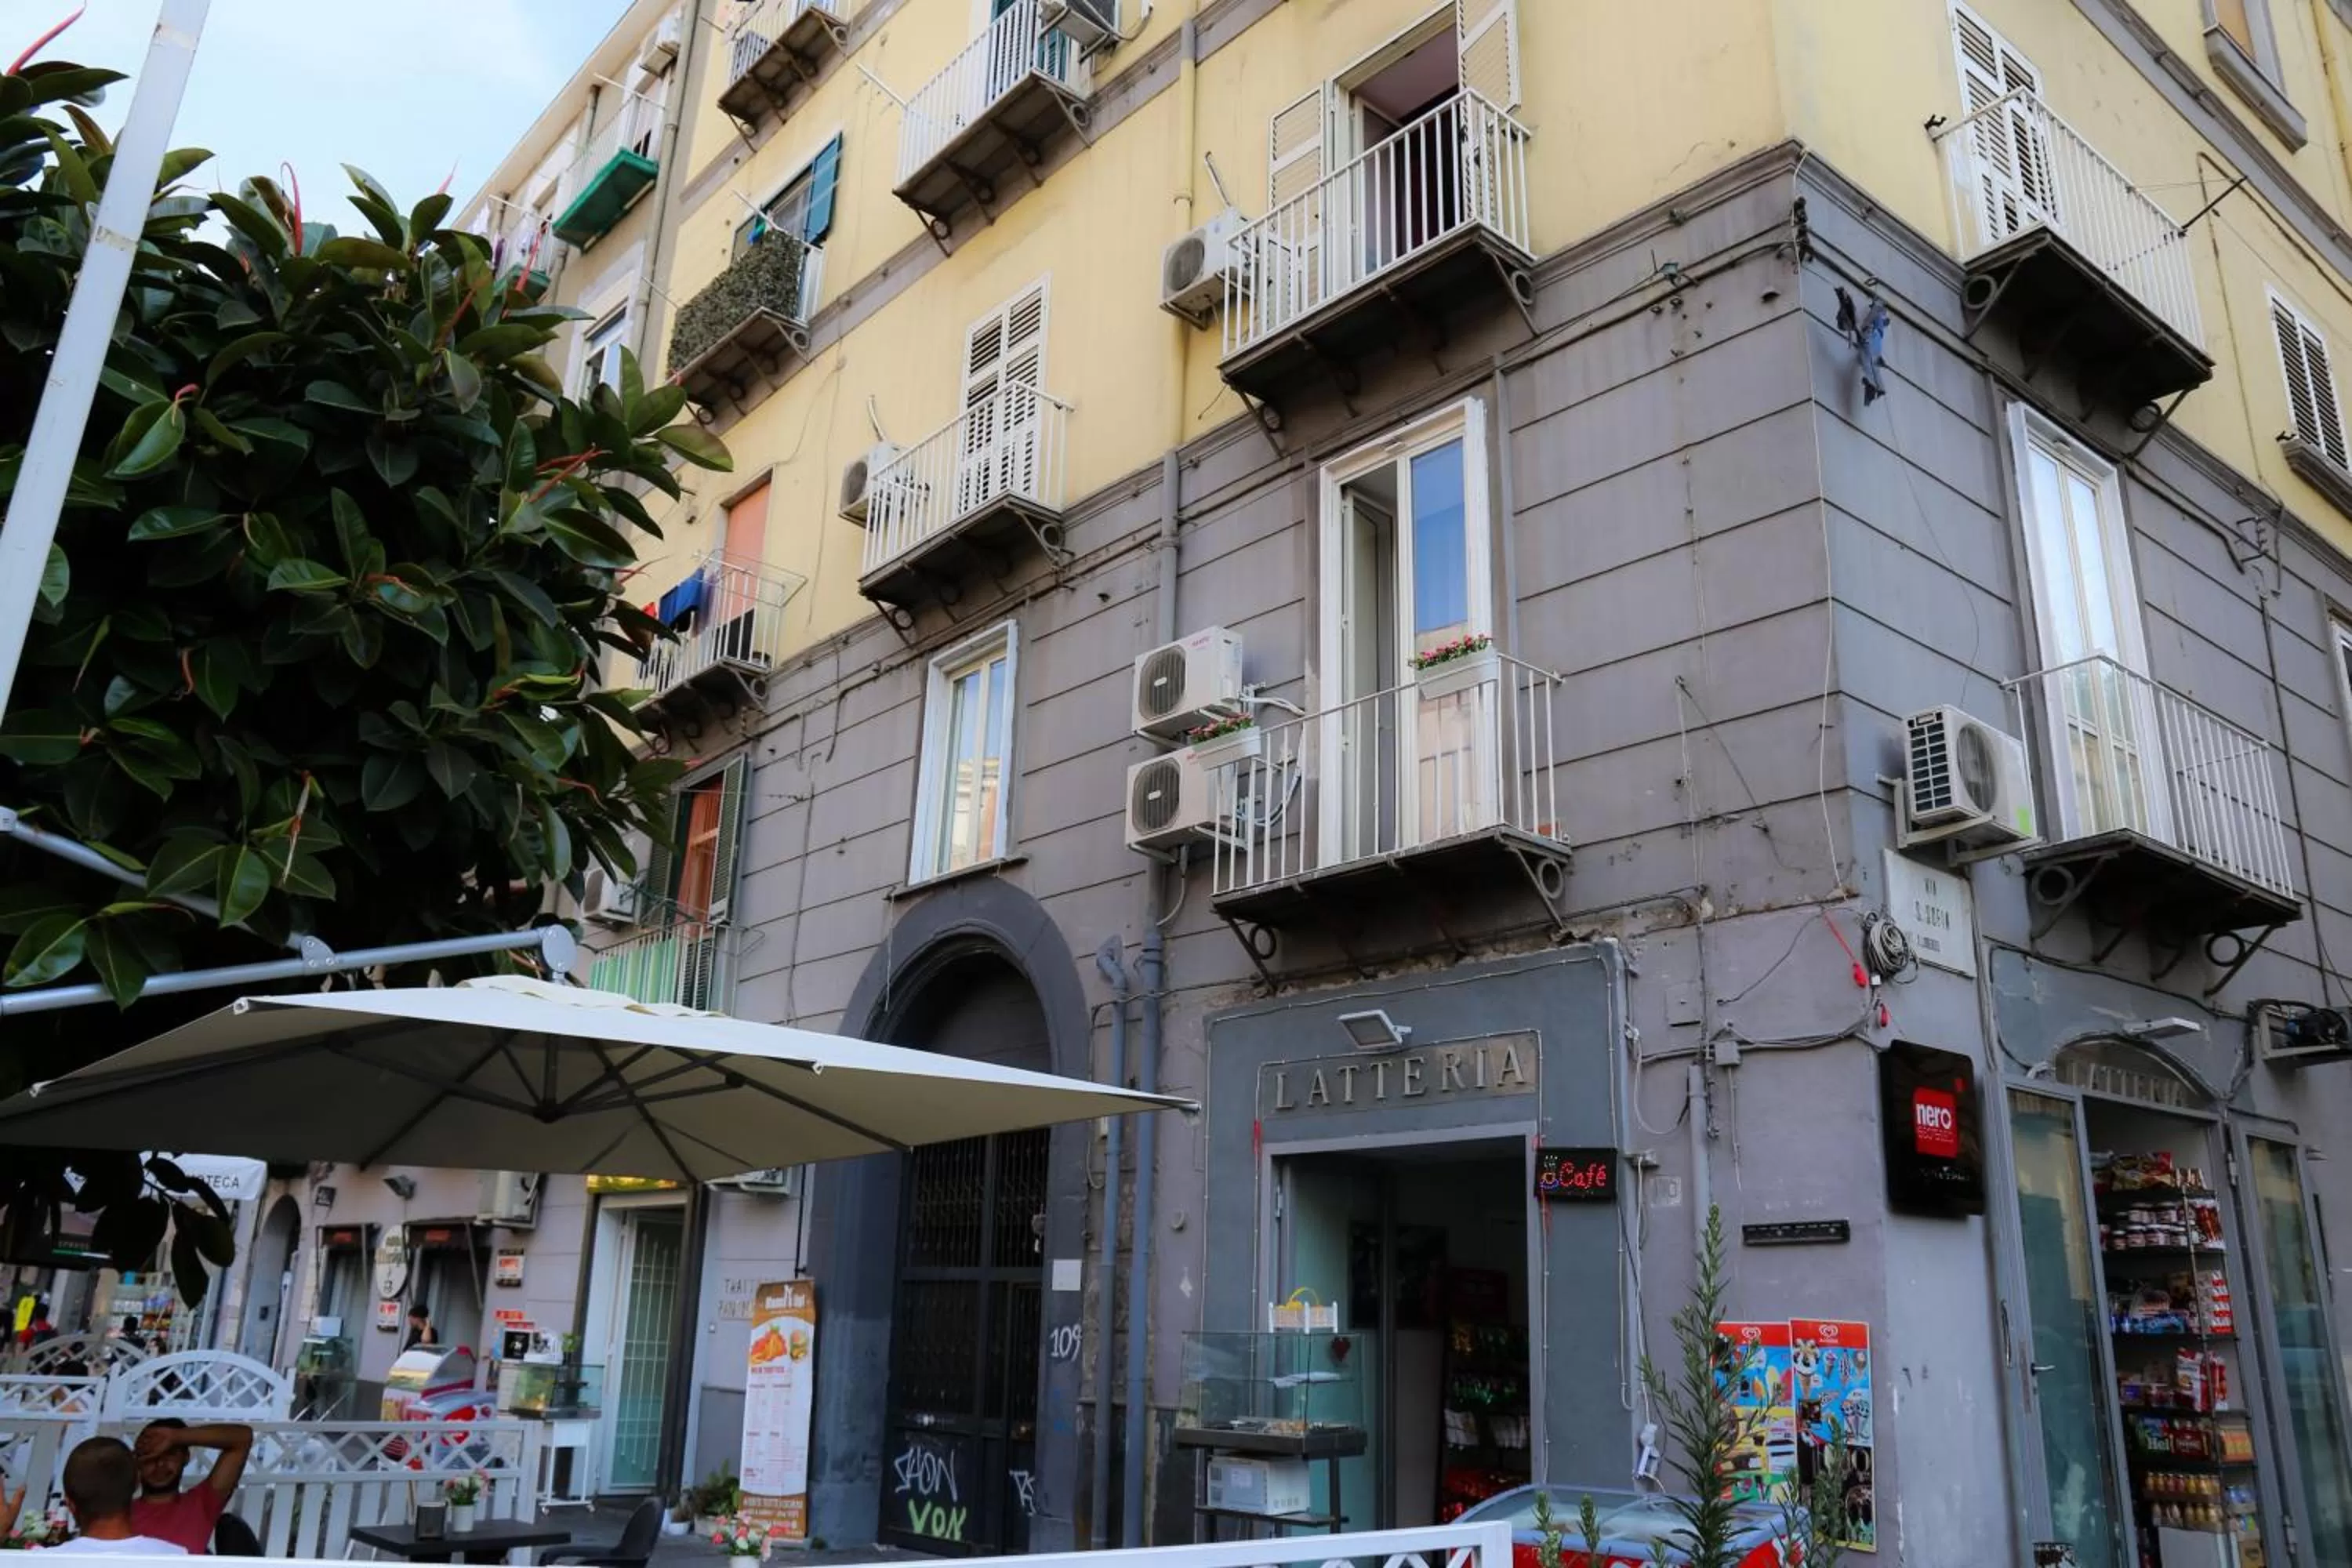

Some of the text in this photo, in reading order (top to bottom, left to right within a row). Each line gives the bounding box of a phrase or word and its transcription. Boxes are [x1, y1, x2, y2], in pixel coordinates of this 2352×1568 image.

[1275, 1044, 1527, 1110] LATTERIA
[1916, 1103, 1952, 1130] nero
[1559, 1160, 1606, 1189] Café
[1051, 1323, 1082, 1362] 109
